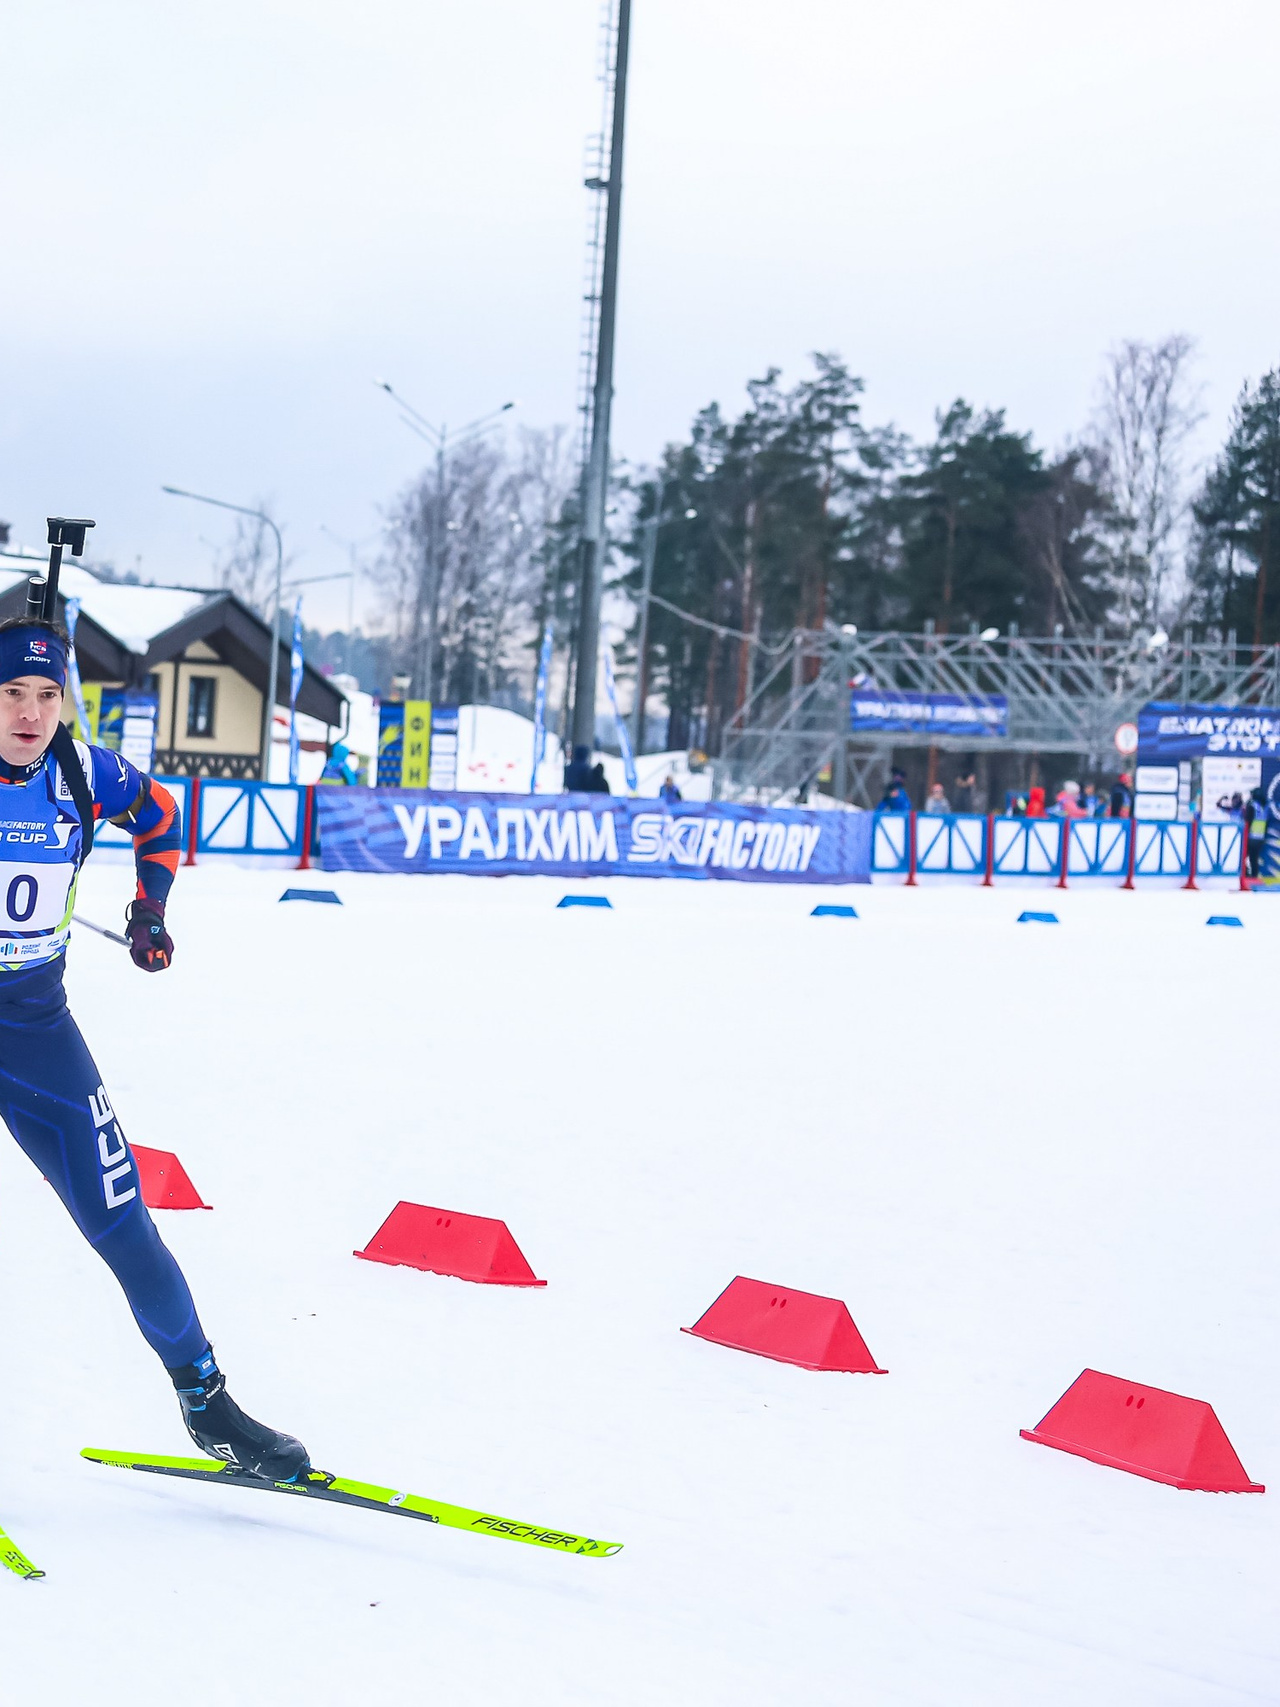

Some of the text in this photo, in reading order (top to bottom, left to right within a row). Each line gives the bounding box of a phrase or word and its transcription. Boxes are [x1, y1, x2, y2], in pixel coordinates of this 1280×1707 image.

[24, 656, 51, 664] СПОРТ
[6, 832, 48, 844] CUP
[394, 804, 619, 862] УРАЛХИМ
[88, 1084, 136, 1210] ПСБ
[471, 1516, 578, 1547] FISCHER
